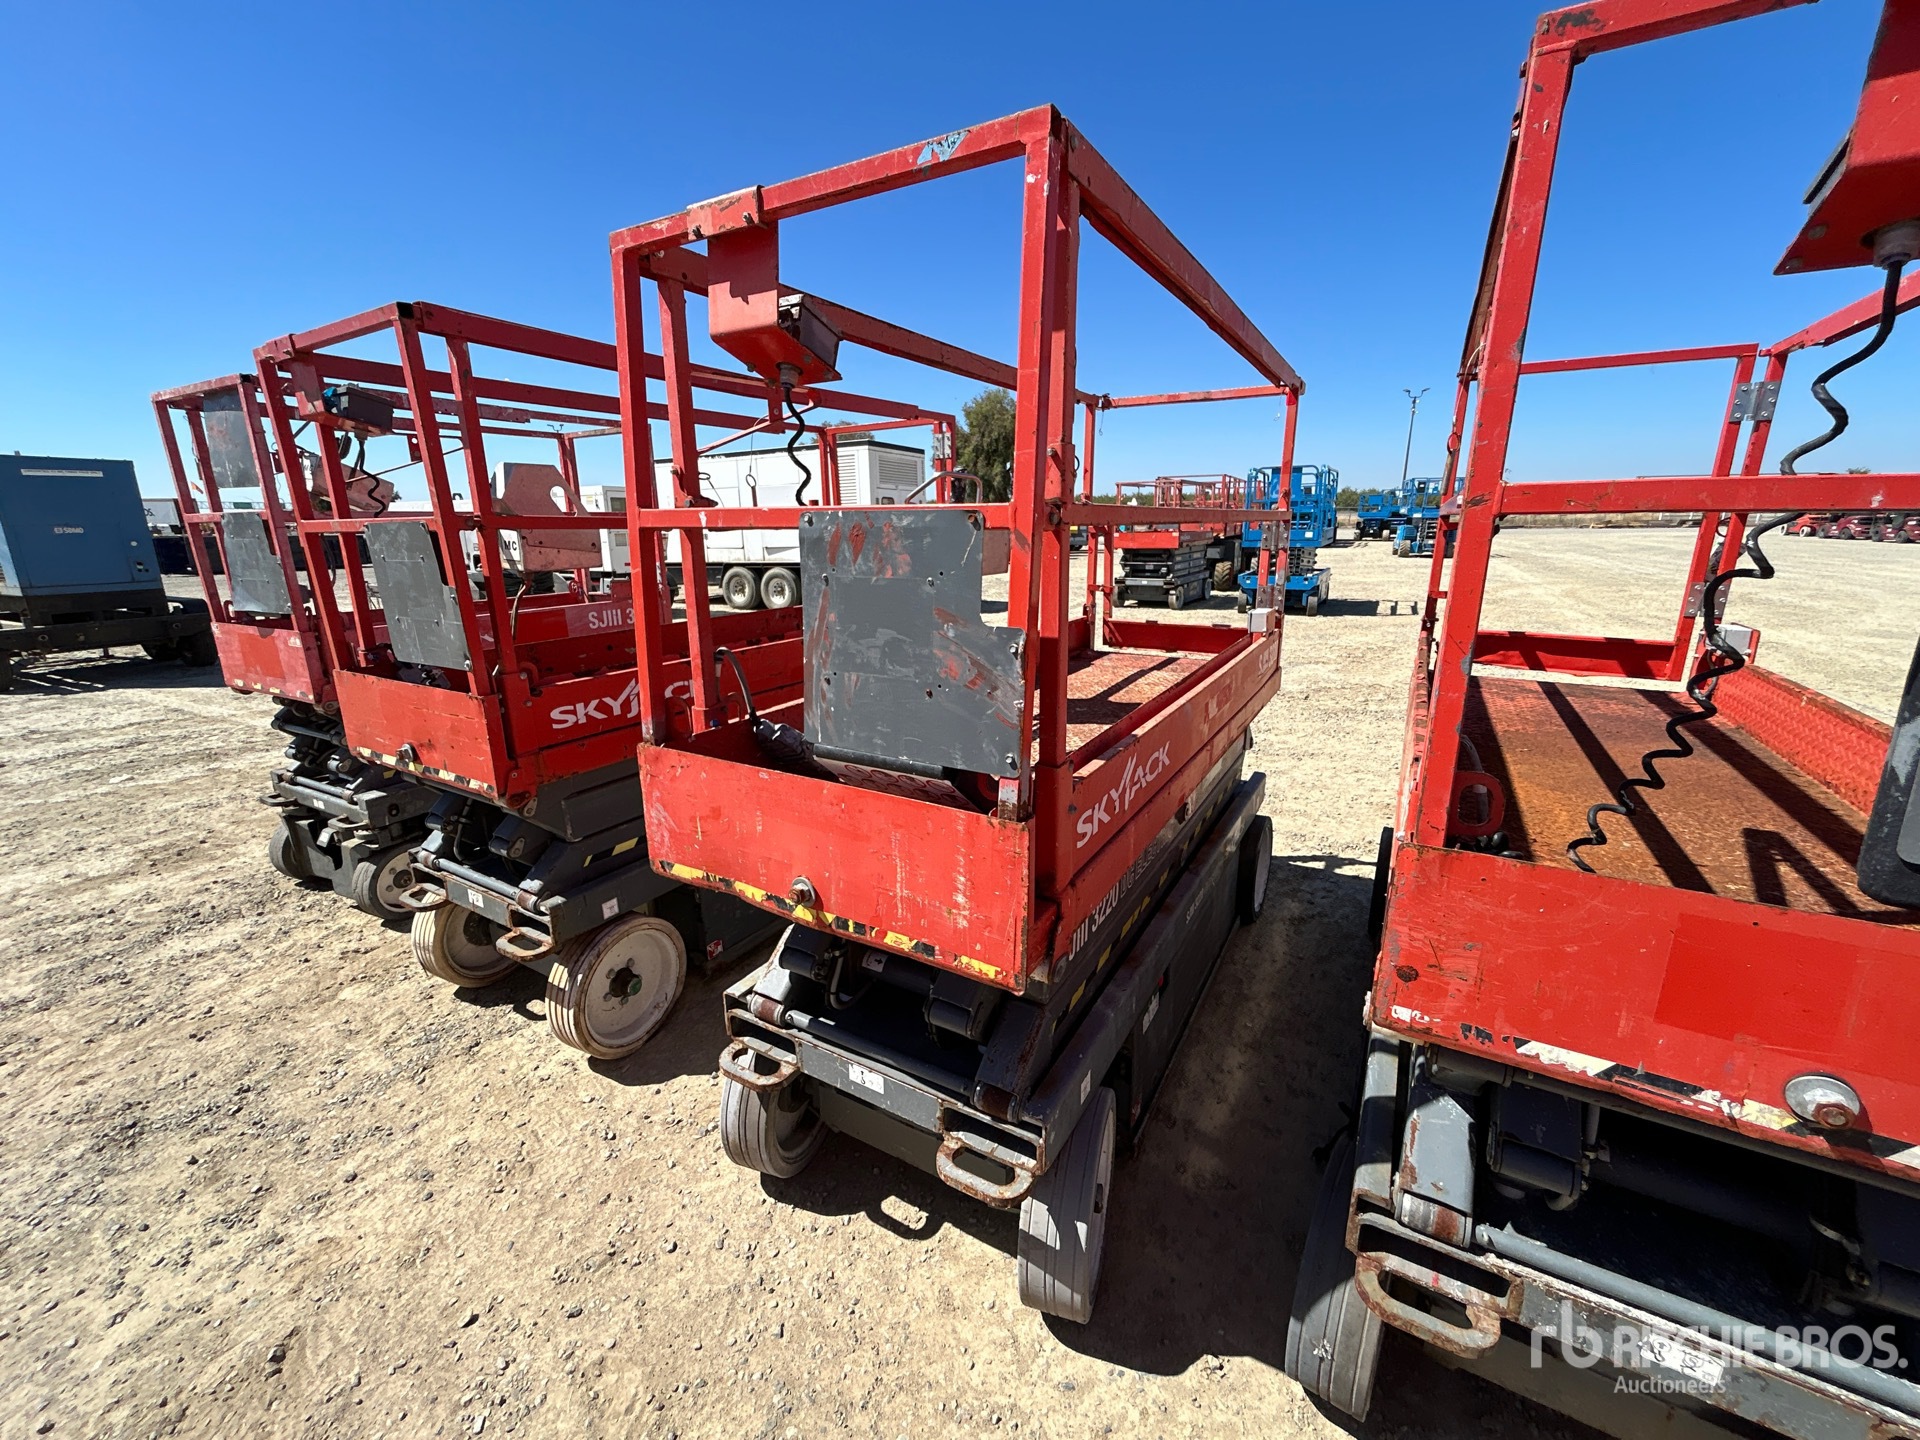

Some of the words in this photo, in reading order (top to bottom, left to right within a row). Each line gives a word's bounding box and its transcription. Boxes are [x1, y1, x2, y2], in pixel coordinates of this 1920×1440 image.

[504, 540, 518, 551] MC
[626, 607, 635, 624] 3
[1076, 740, 1171, 849] SKYJACK
[1091, 882, 1120, 933] 3220
